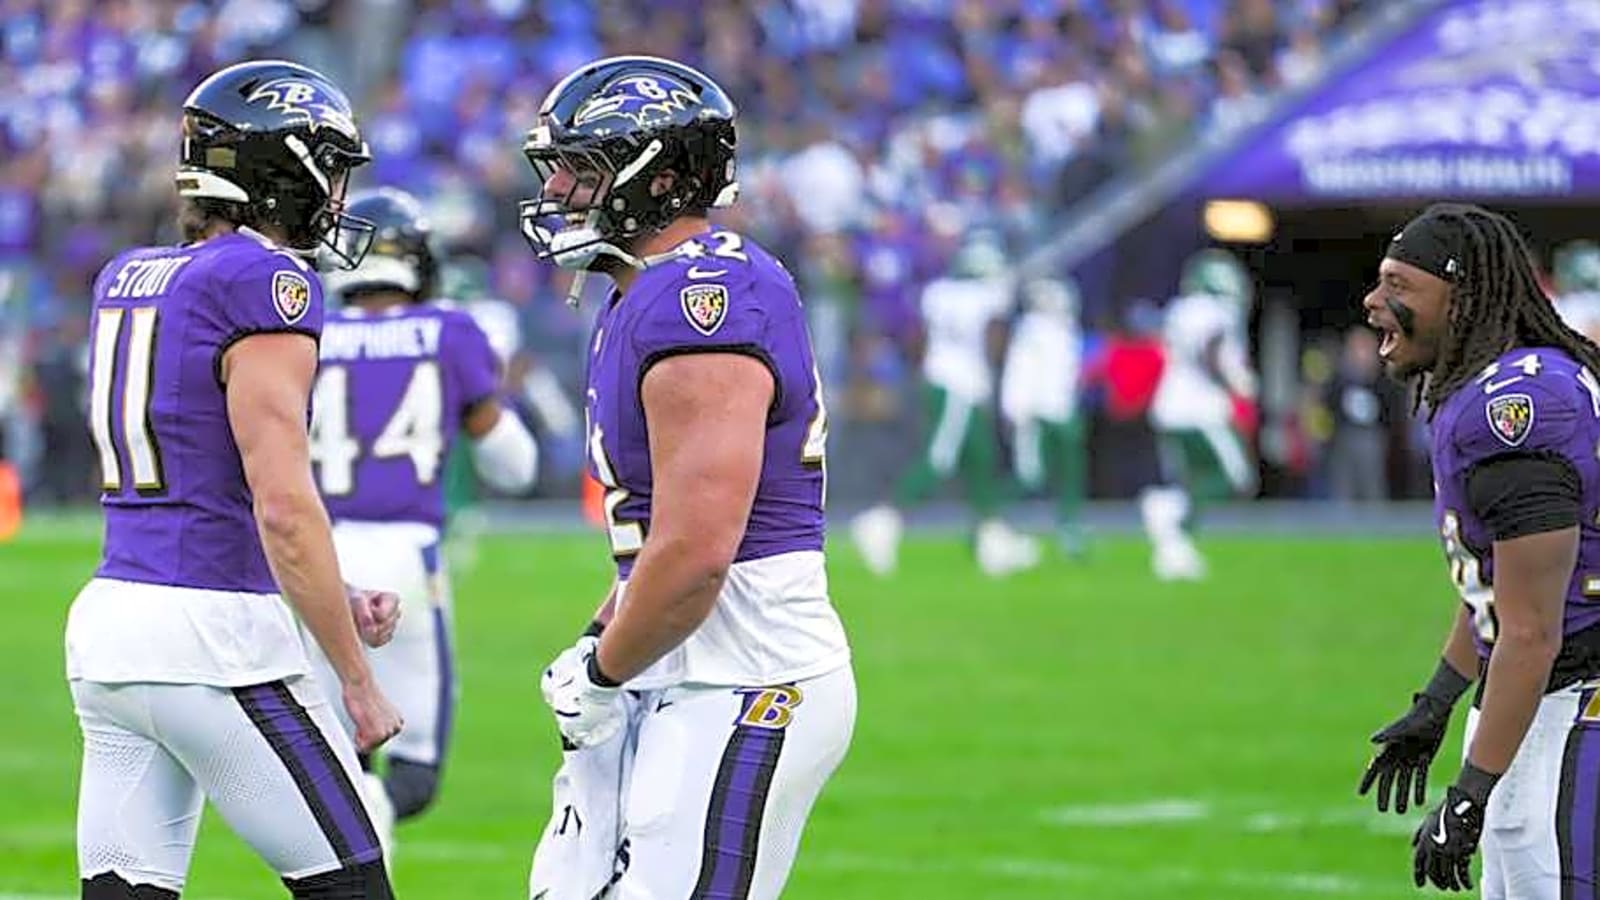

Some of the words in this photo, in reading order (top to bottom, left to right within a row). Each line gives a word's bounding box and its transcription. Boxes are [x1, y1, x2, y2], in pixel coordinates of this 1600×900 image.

[278, 83, 316, 104] B
[91, 307, 165, 489] 11
[308, 360, 444, 495] 44
[733, 685, 803, 730] B
